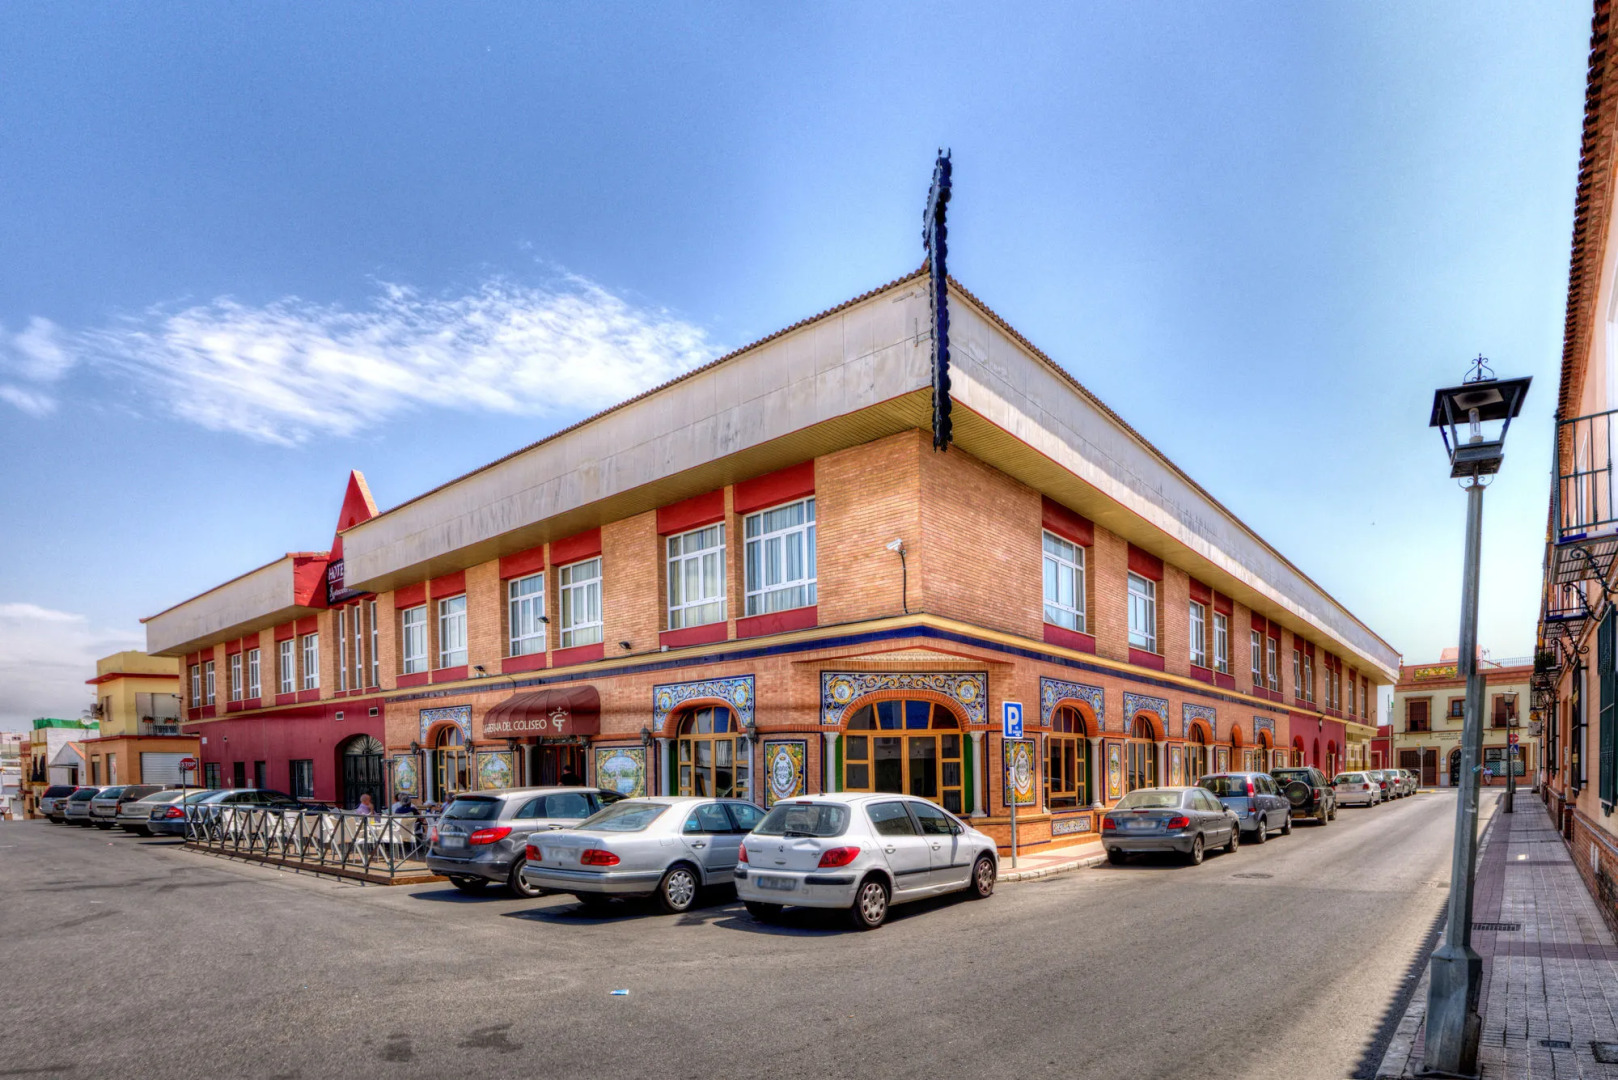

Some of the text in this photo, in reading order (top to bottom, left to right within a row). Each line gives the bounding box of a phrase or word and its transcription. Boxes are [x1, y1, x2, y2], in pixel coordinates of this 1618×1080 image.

[328, 562, 344, 581] HOTE
[502, 721, 512, 732] DEL
[513, 719, 547, 731] COLISEO
[1007, 706, 1020, 734] P
